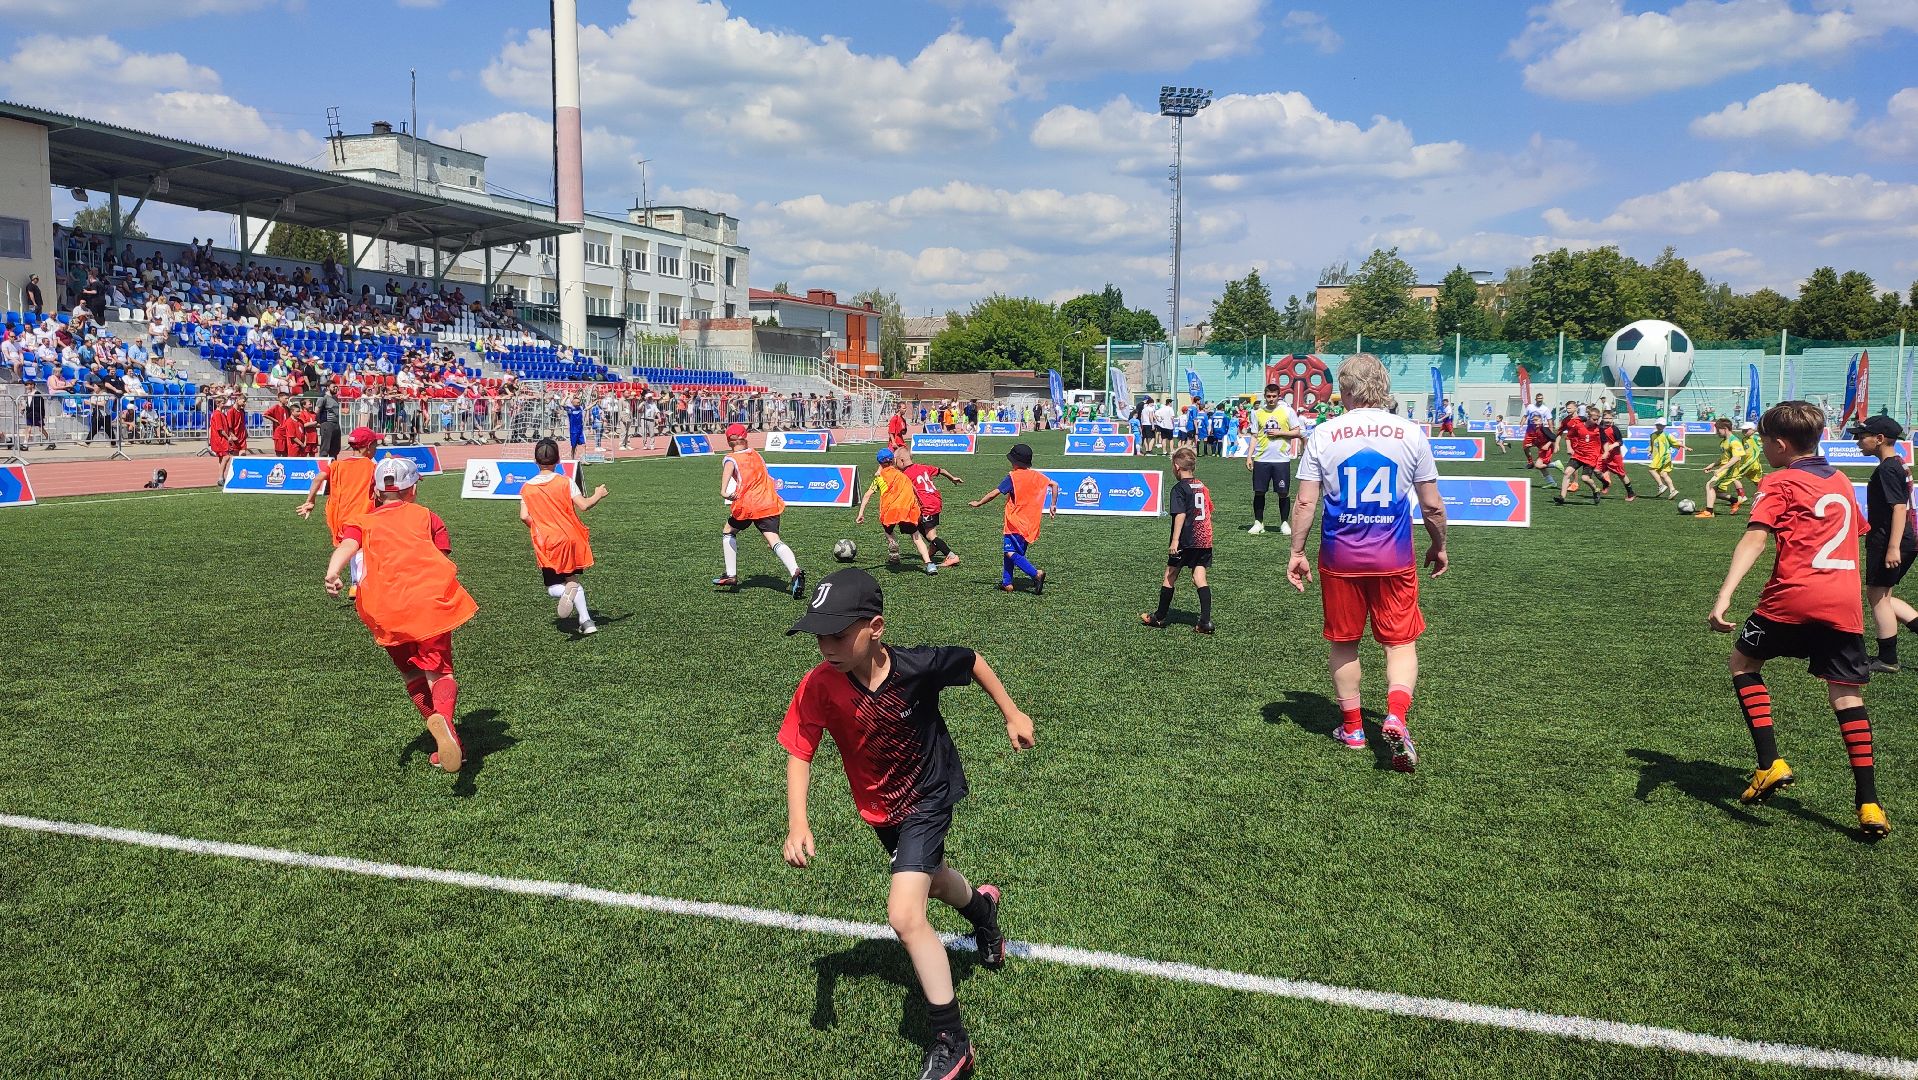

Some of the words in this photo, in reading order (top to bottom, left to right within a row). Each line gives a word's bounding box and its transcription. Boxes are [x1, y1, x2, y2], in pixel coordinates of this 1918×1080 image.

[1331, 425, 1404, 442] ИВАНОВ
[1343, 466, 1393, 509] 14
[1194, 492, 1206, 521] 9
[1811, 493, 1856, 570] 2
